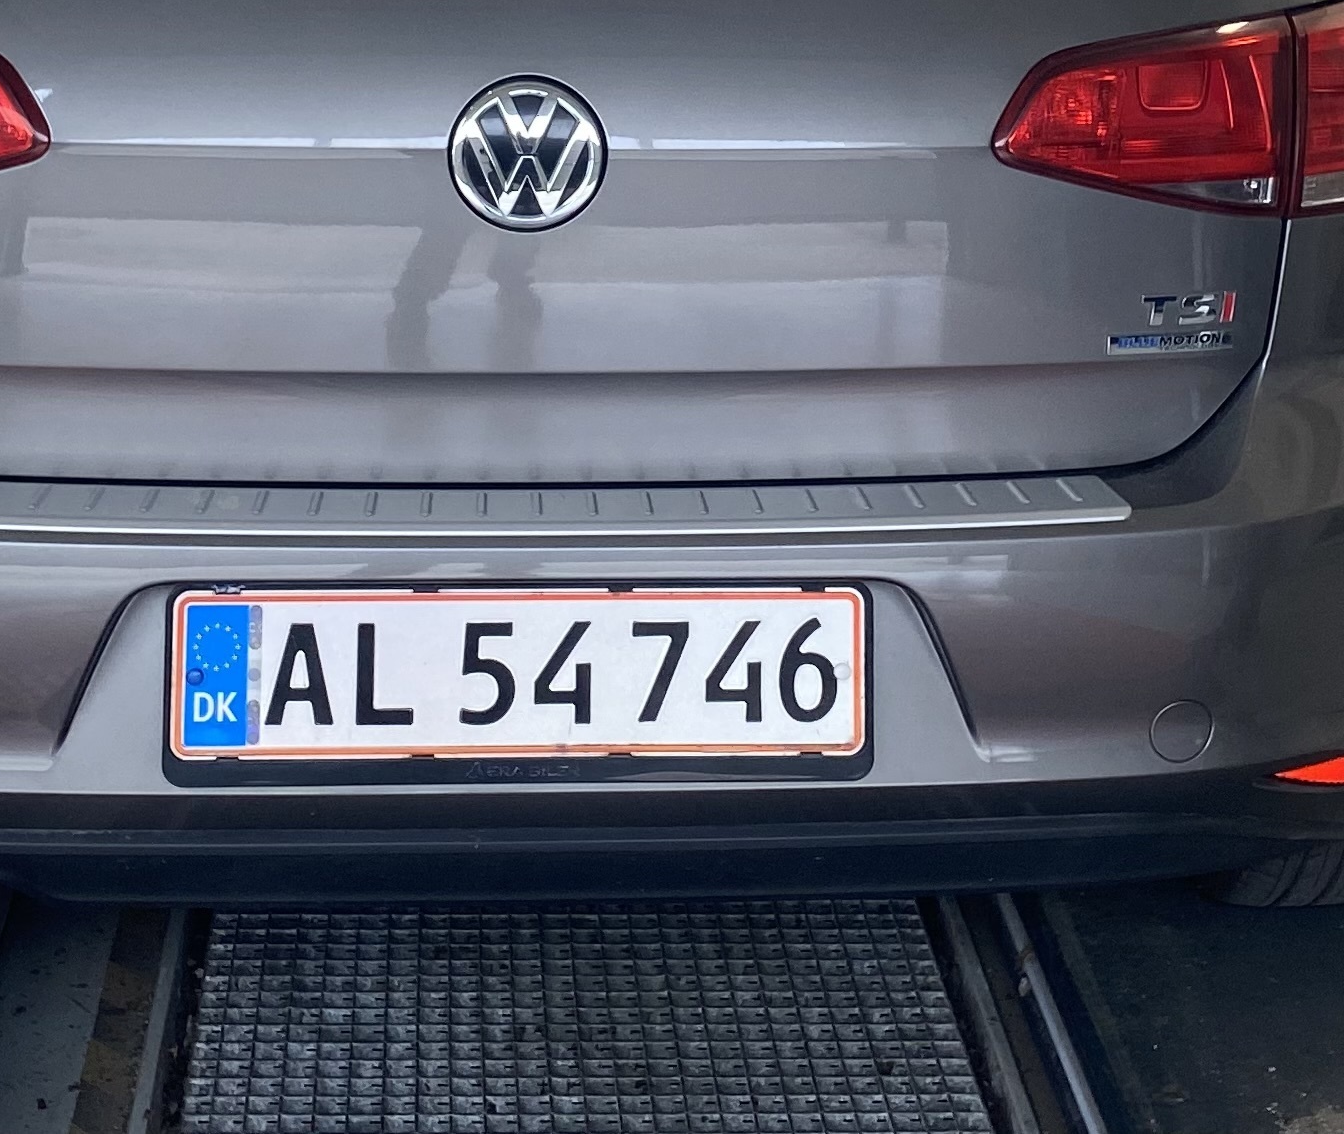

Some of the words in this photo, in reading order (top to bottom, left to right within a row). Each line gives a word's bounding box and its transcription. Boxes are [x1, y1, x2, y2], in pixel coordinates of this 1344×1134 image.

[1142, 291, 1236, 325] TSI
[264, 622, 414, 726] AL
[459, 621, 592, 725] 54
[631, 617, 839, 724] 746
[193, 691, 238, 724] DK
